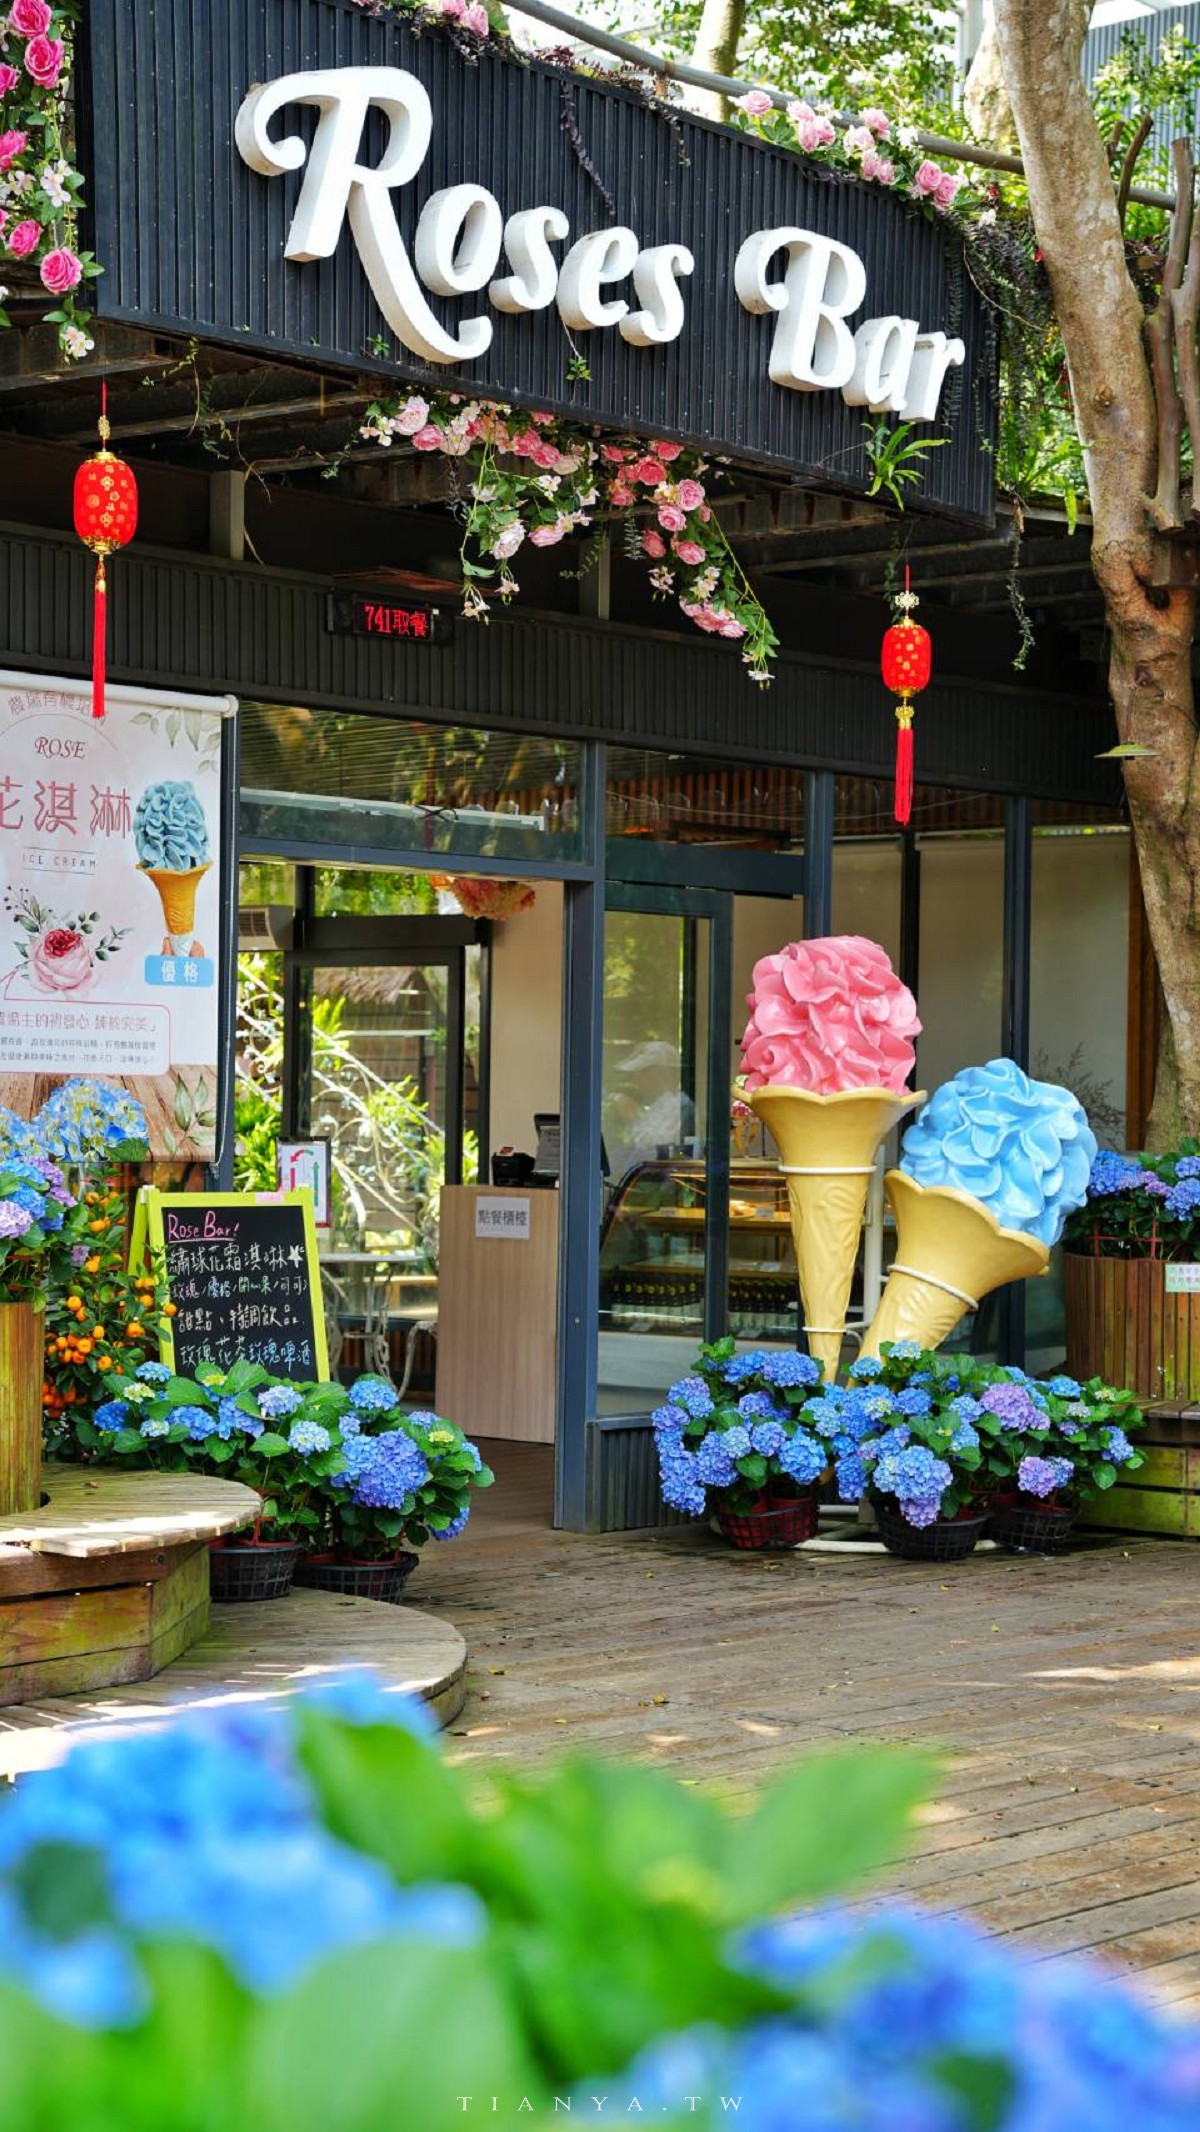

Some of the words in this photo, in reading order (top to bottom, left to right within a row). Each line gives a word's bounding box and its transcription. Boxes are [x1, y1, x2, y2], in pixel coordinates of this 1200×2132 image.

[234, 65, 694, 364] Roses
[735, 226, 965, 423] Bar
[34, 736, 87, 760] ROSE
[22, 853, 44, 865] ICE
[53, 855, 97, 868] CREAM
[168, 1213, 200, 1241] Rose
[203, 1210, 240, 1239] Bar!
